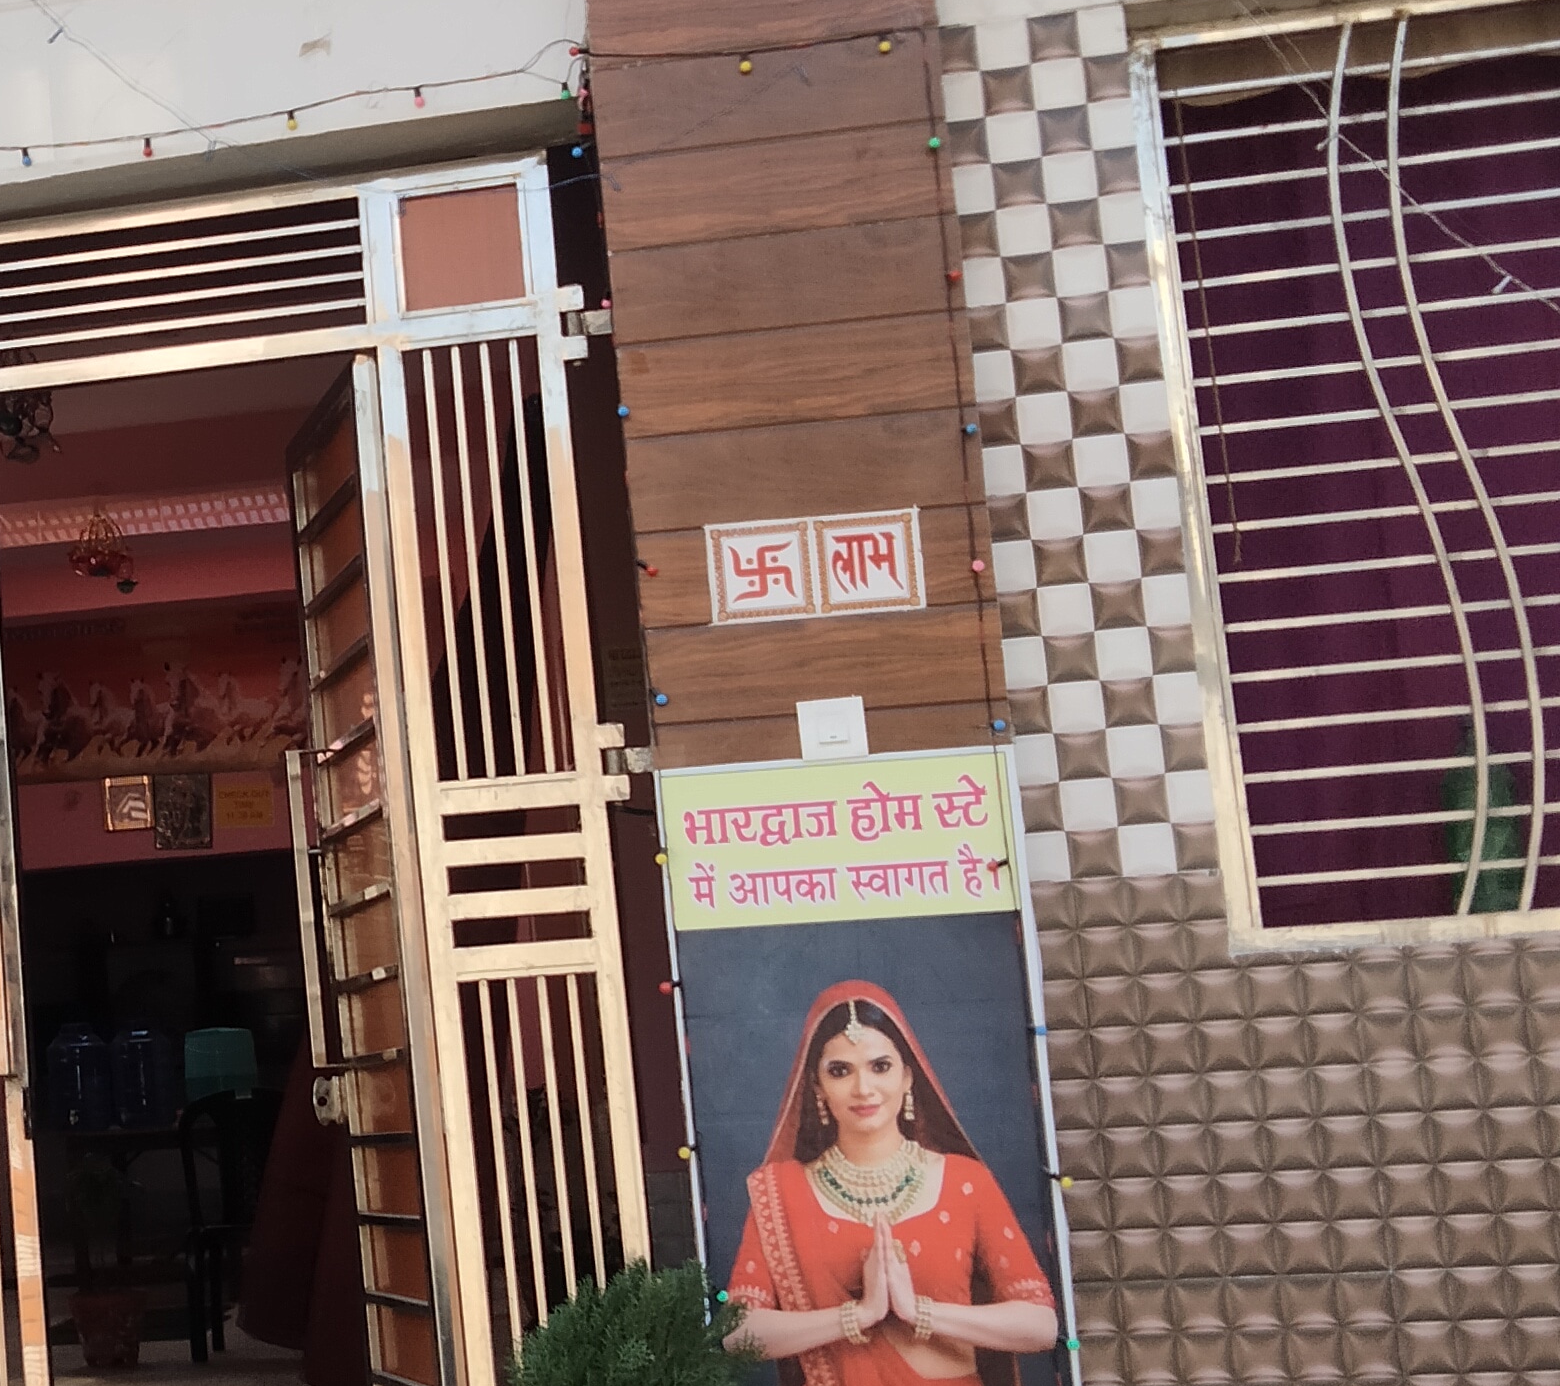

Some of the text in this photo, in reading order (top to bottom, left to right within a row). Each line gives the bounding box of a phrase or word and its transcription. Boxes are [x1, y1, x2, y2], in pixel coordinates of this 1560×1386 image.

[831, 530, 905, 595] लाभ
[683, 774, 989, 847] भारद्वाज होम स्टे
[688, 862, 716, 909] में
[728, 866, 839, 907] आपका
[845, 860, 949, 901] स्वागत
